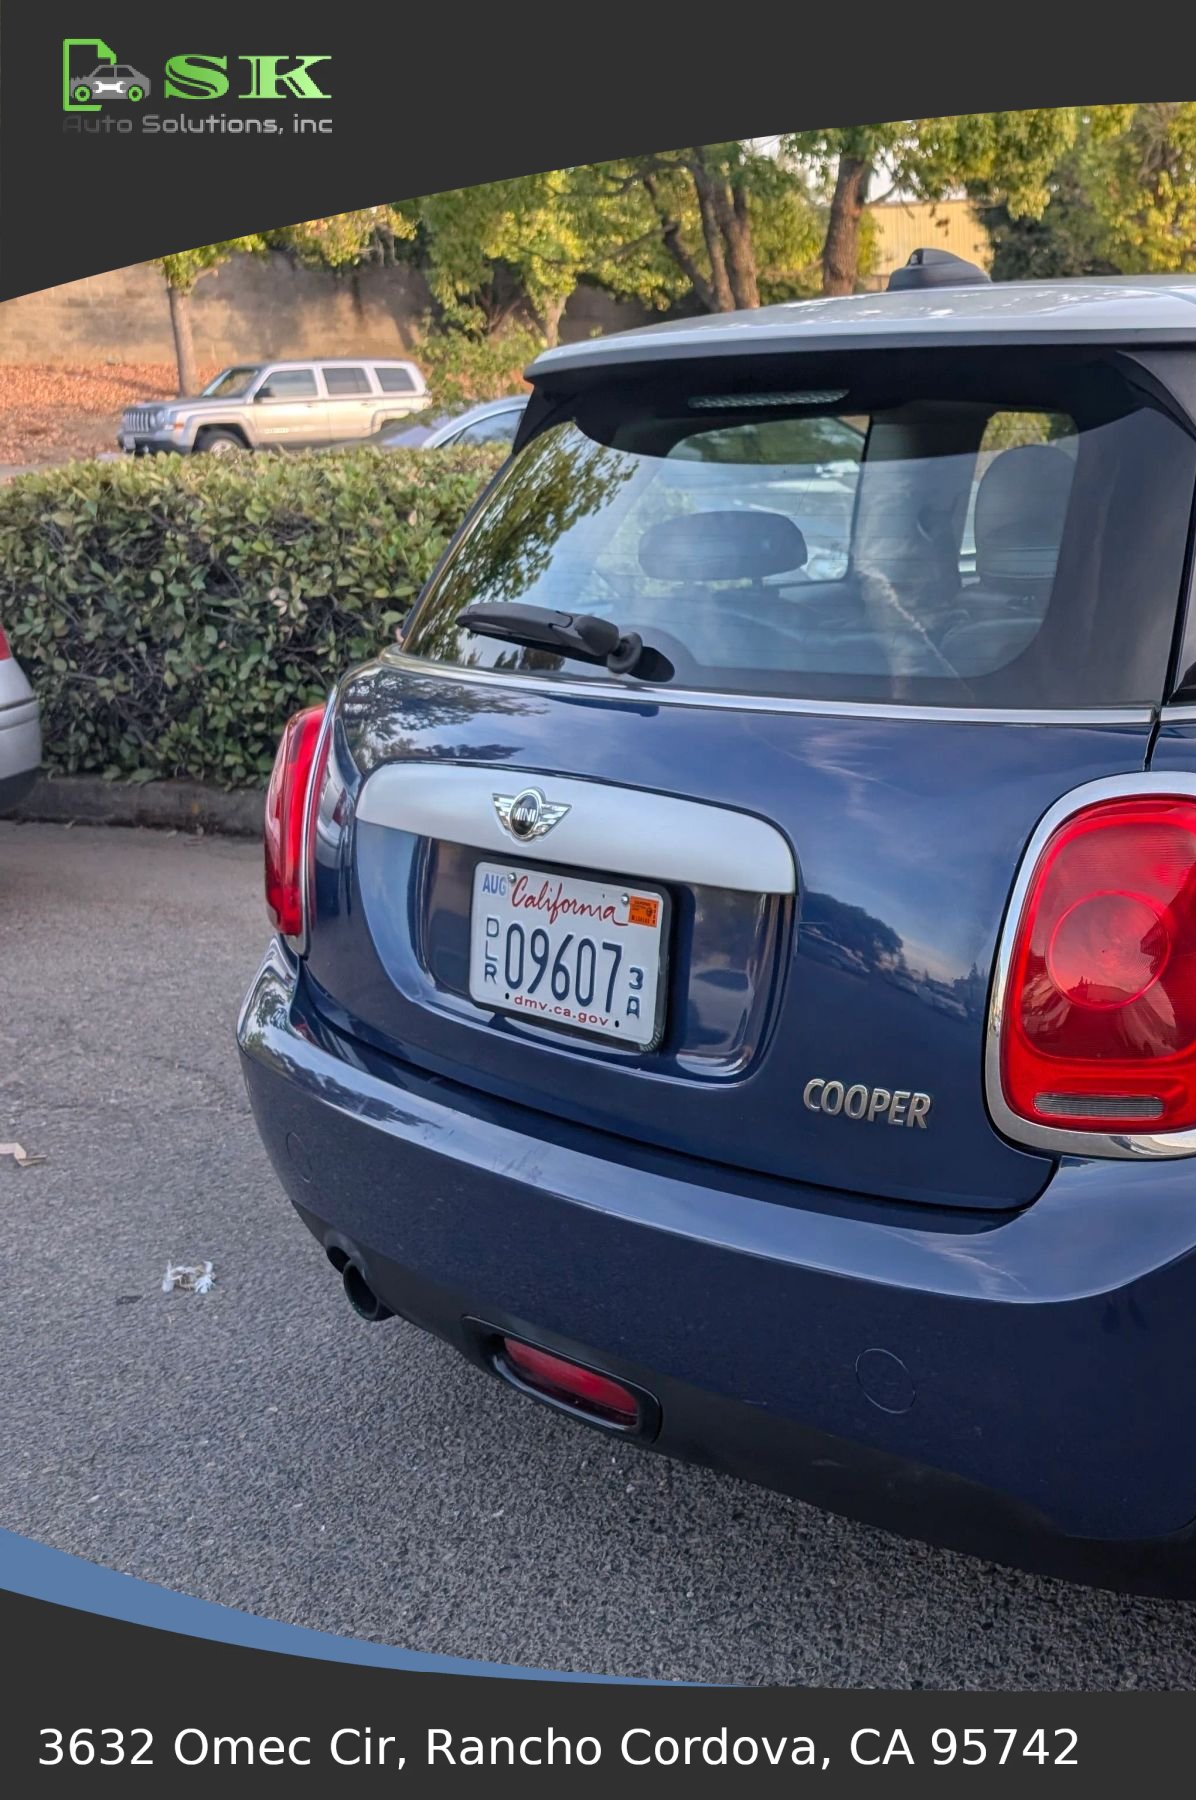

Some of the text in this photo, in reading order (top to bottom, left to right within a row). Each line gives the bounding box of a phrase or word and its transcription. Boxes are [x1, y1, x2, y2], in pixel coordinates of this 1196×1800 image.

[482, 873, 507, 896] AUG
[511, 875, 628, 926] California
[504, 923, 622, 1013] 09607
[514, 995, 609, 1026] dmv.ca.gov
[802, 1078, 931, 1130] COOPER
